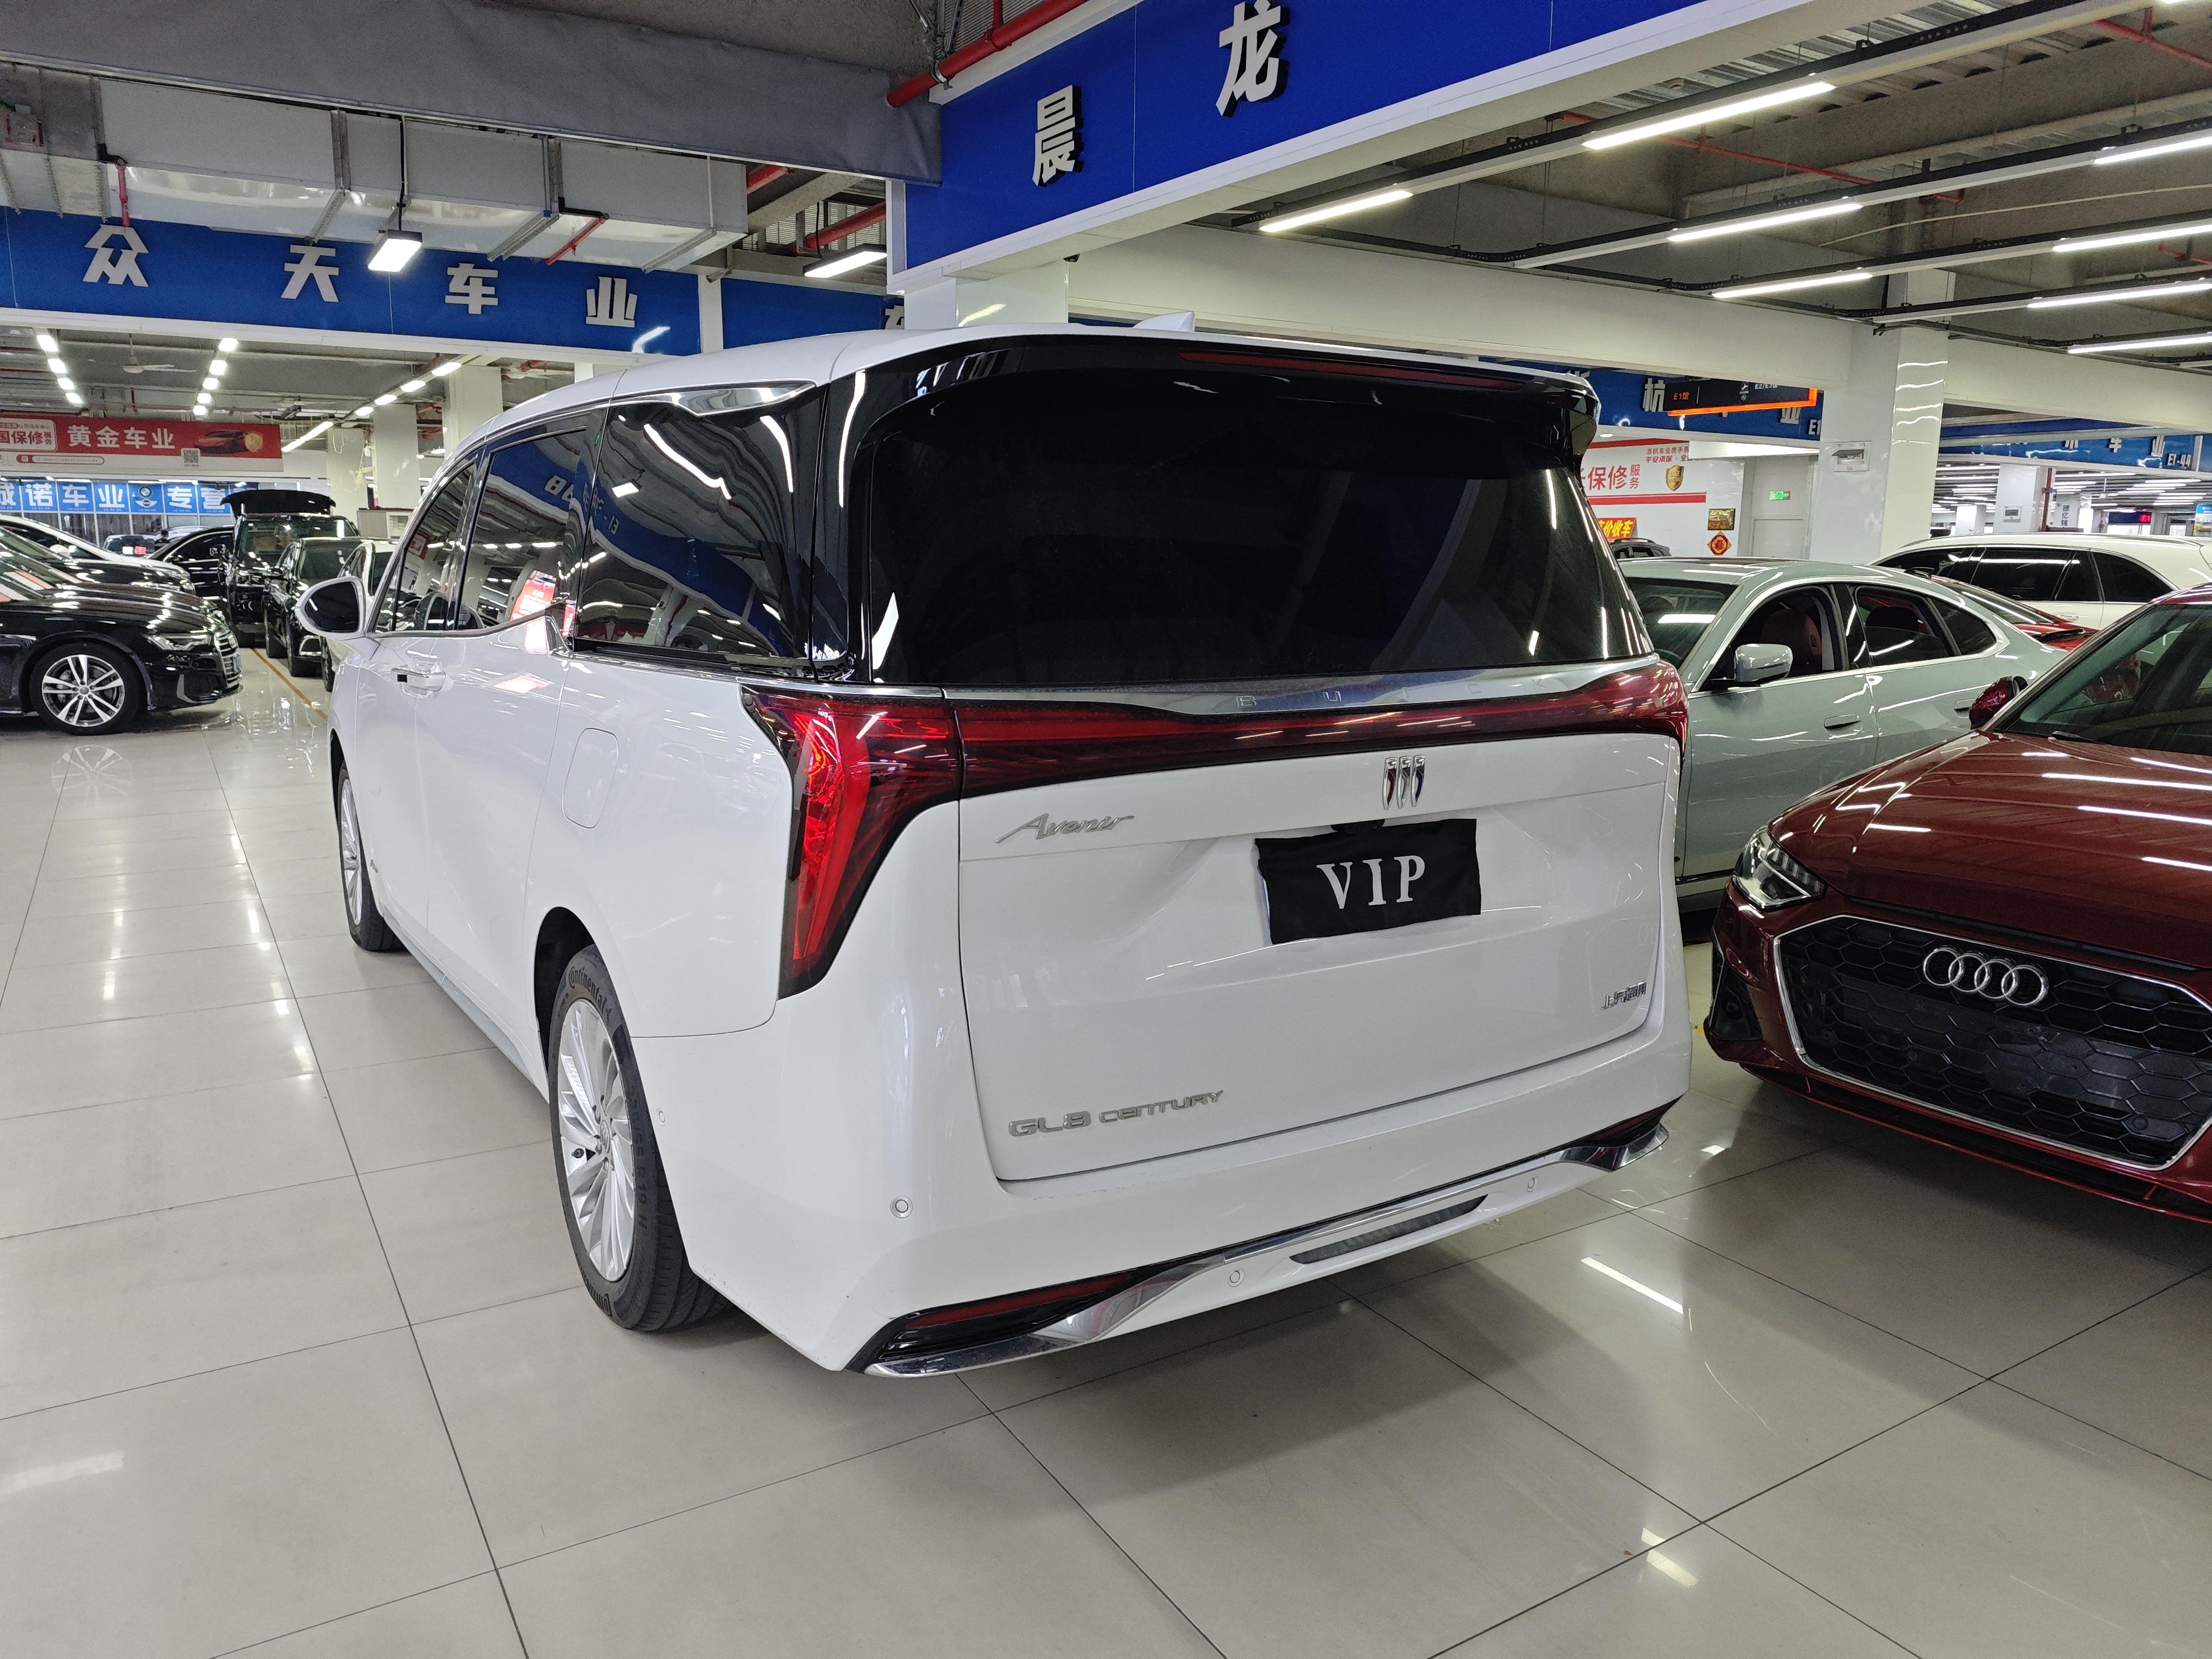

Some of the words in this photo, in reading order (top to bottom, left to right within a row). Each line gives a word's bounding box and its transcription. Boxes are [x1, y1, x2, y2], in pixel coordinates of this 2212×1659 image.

[1032, 0, 1285, 187] 晨龙
[82, 224, 638, 328] 众天车业
[67, 424, 176, 449] 黄金车业
[1581, 465, 1628, 490] 保修
[1629, 464, 1641, 489] 服务
[994, 813, 1135, 844] Avenir
[1316, 854, 1426, 910] VIP
[568, 966, 608, 1015] Continental
[1008, 1110, 1091, 1137] GL8
